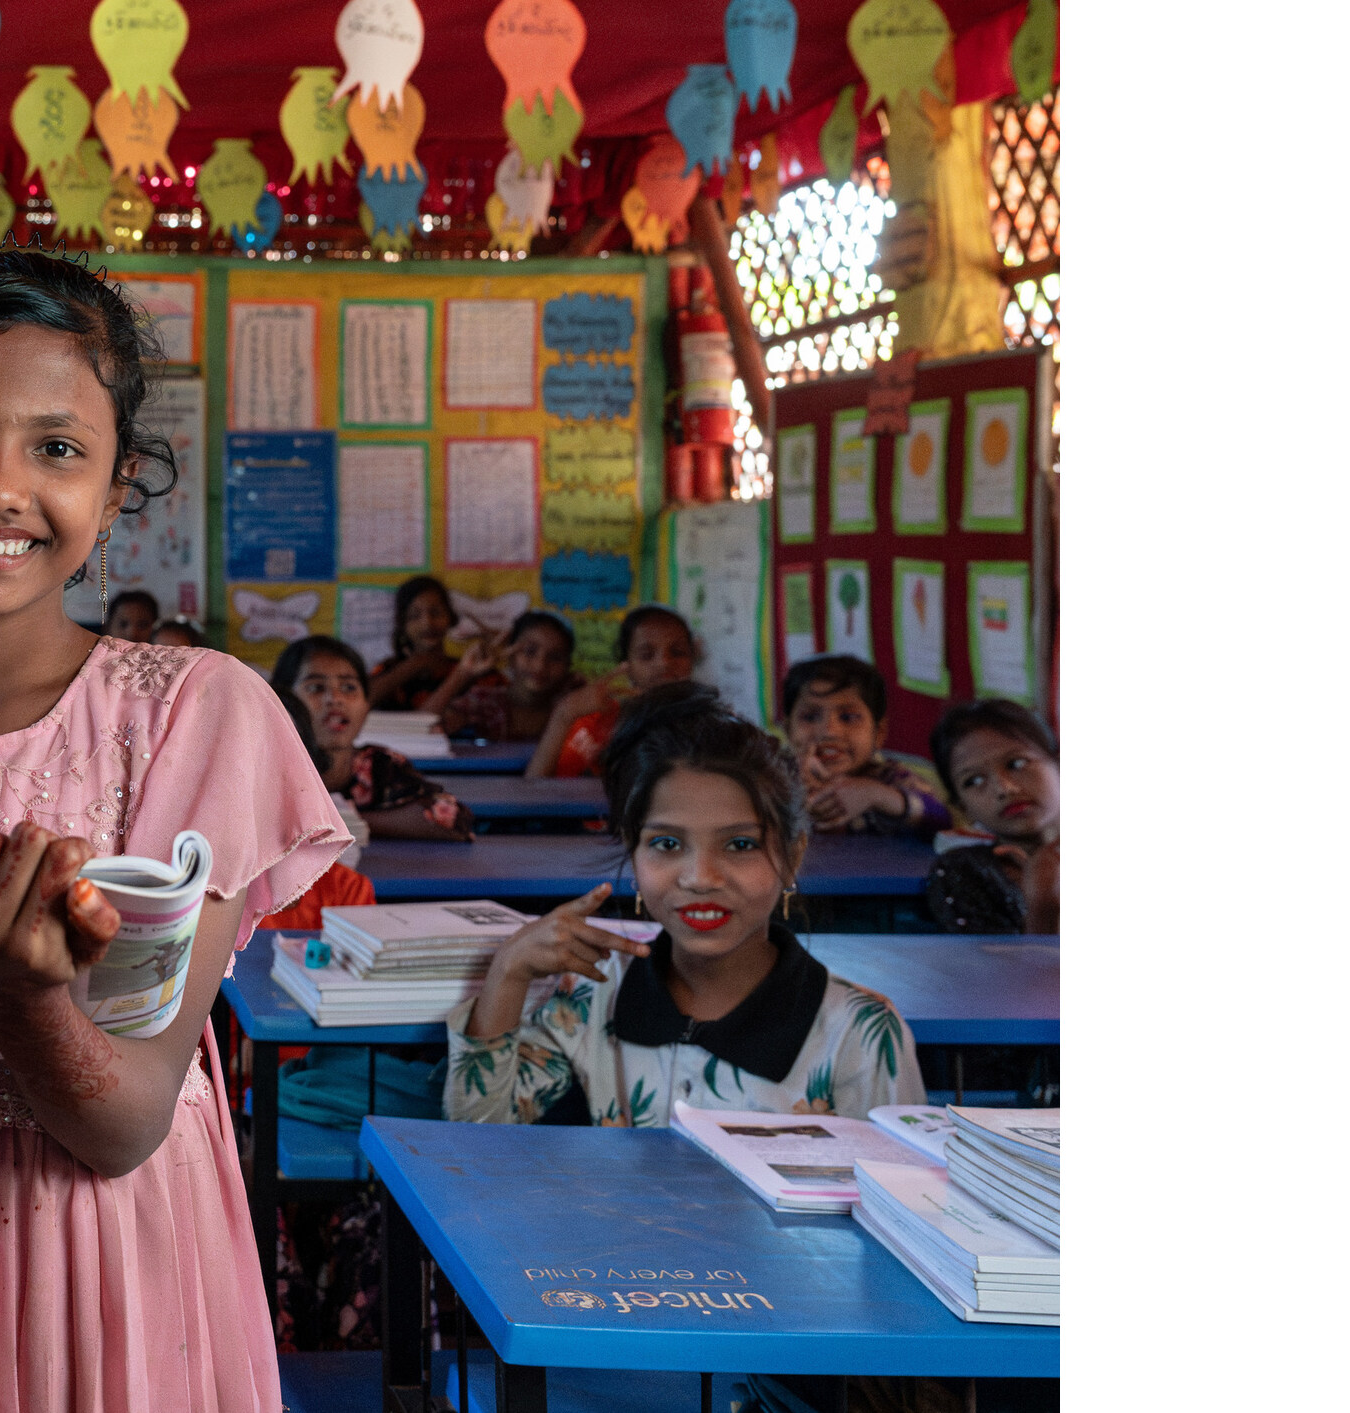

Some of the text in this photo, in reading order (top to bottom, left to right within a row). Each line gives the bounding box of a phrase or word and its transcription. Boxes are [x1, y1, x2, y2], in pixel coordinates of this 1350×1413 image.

[525, 1267, 748, 1284] for every child
[611, 1291, 775, 1315] unicef
